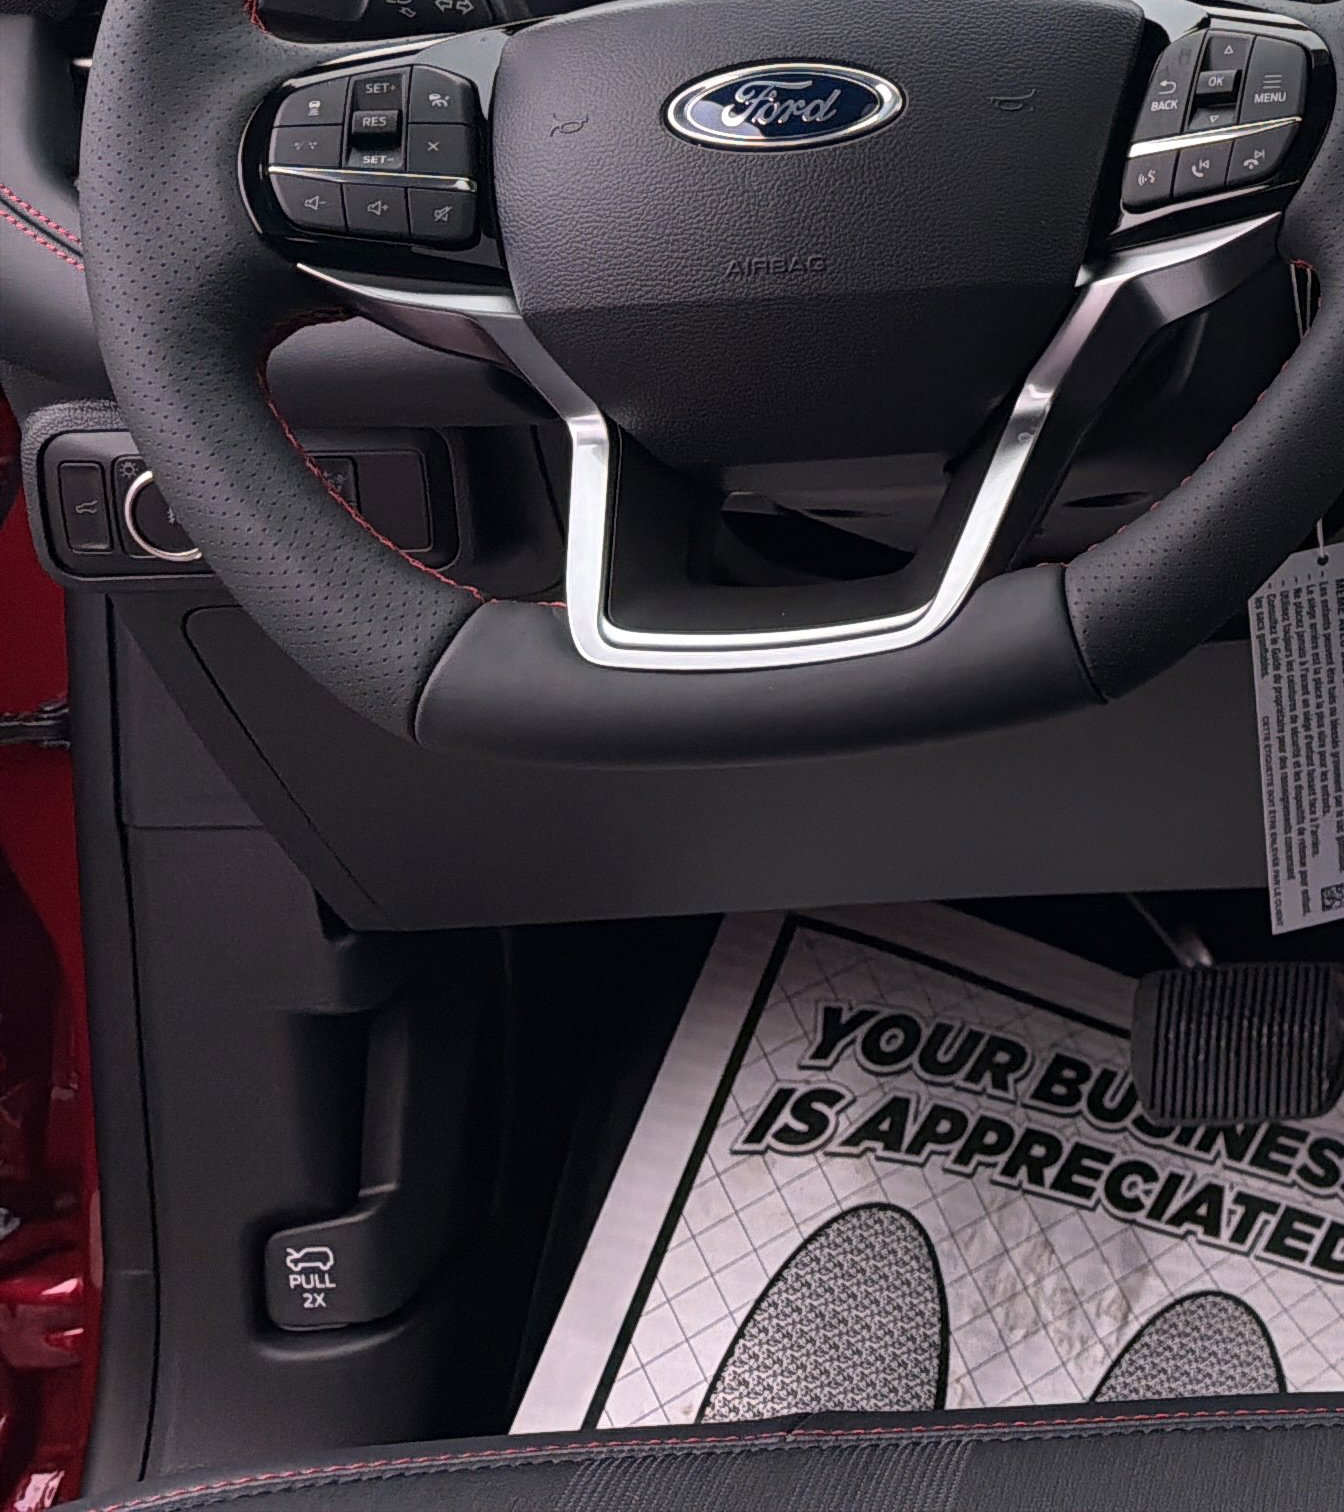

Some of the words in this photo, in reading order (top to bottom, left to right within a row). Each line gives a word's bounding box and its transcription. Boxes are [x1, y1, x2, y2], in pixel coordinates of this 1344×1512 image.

[1208, 76, 1224, 88] OK
[722, 80, 842, 126] Ford
[1254, 91, 1287, 104] MENU
[1150, 100, 1179, 112] BACK
[362, 116, 387, 128] RES
[725, 254, 828, 278] AIRBAG
[808, 1004, 1028, 1087] YOUR
[742, 1086, 842, 1151] IS
[289, 1274, 336, 1289] PULL
[302, 1293, 327, 1308] 2X
